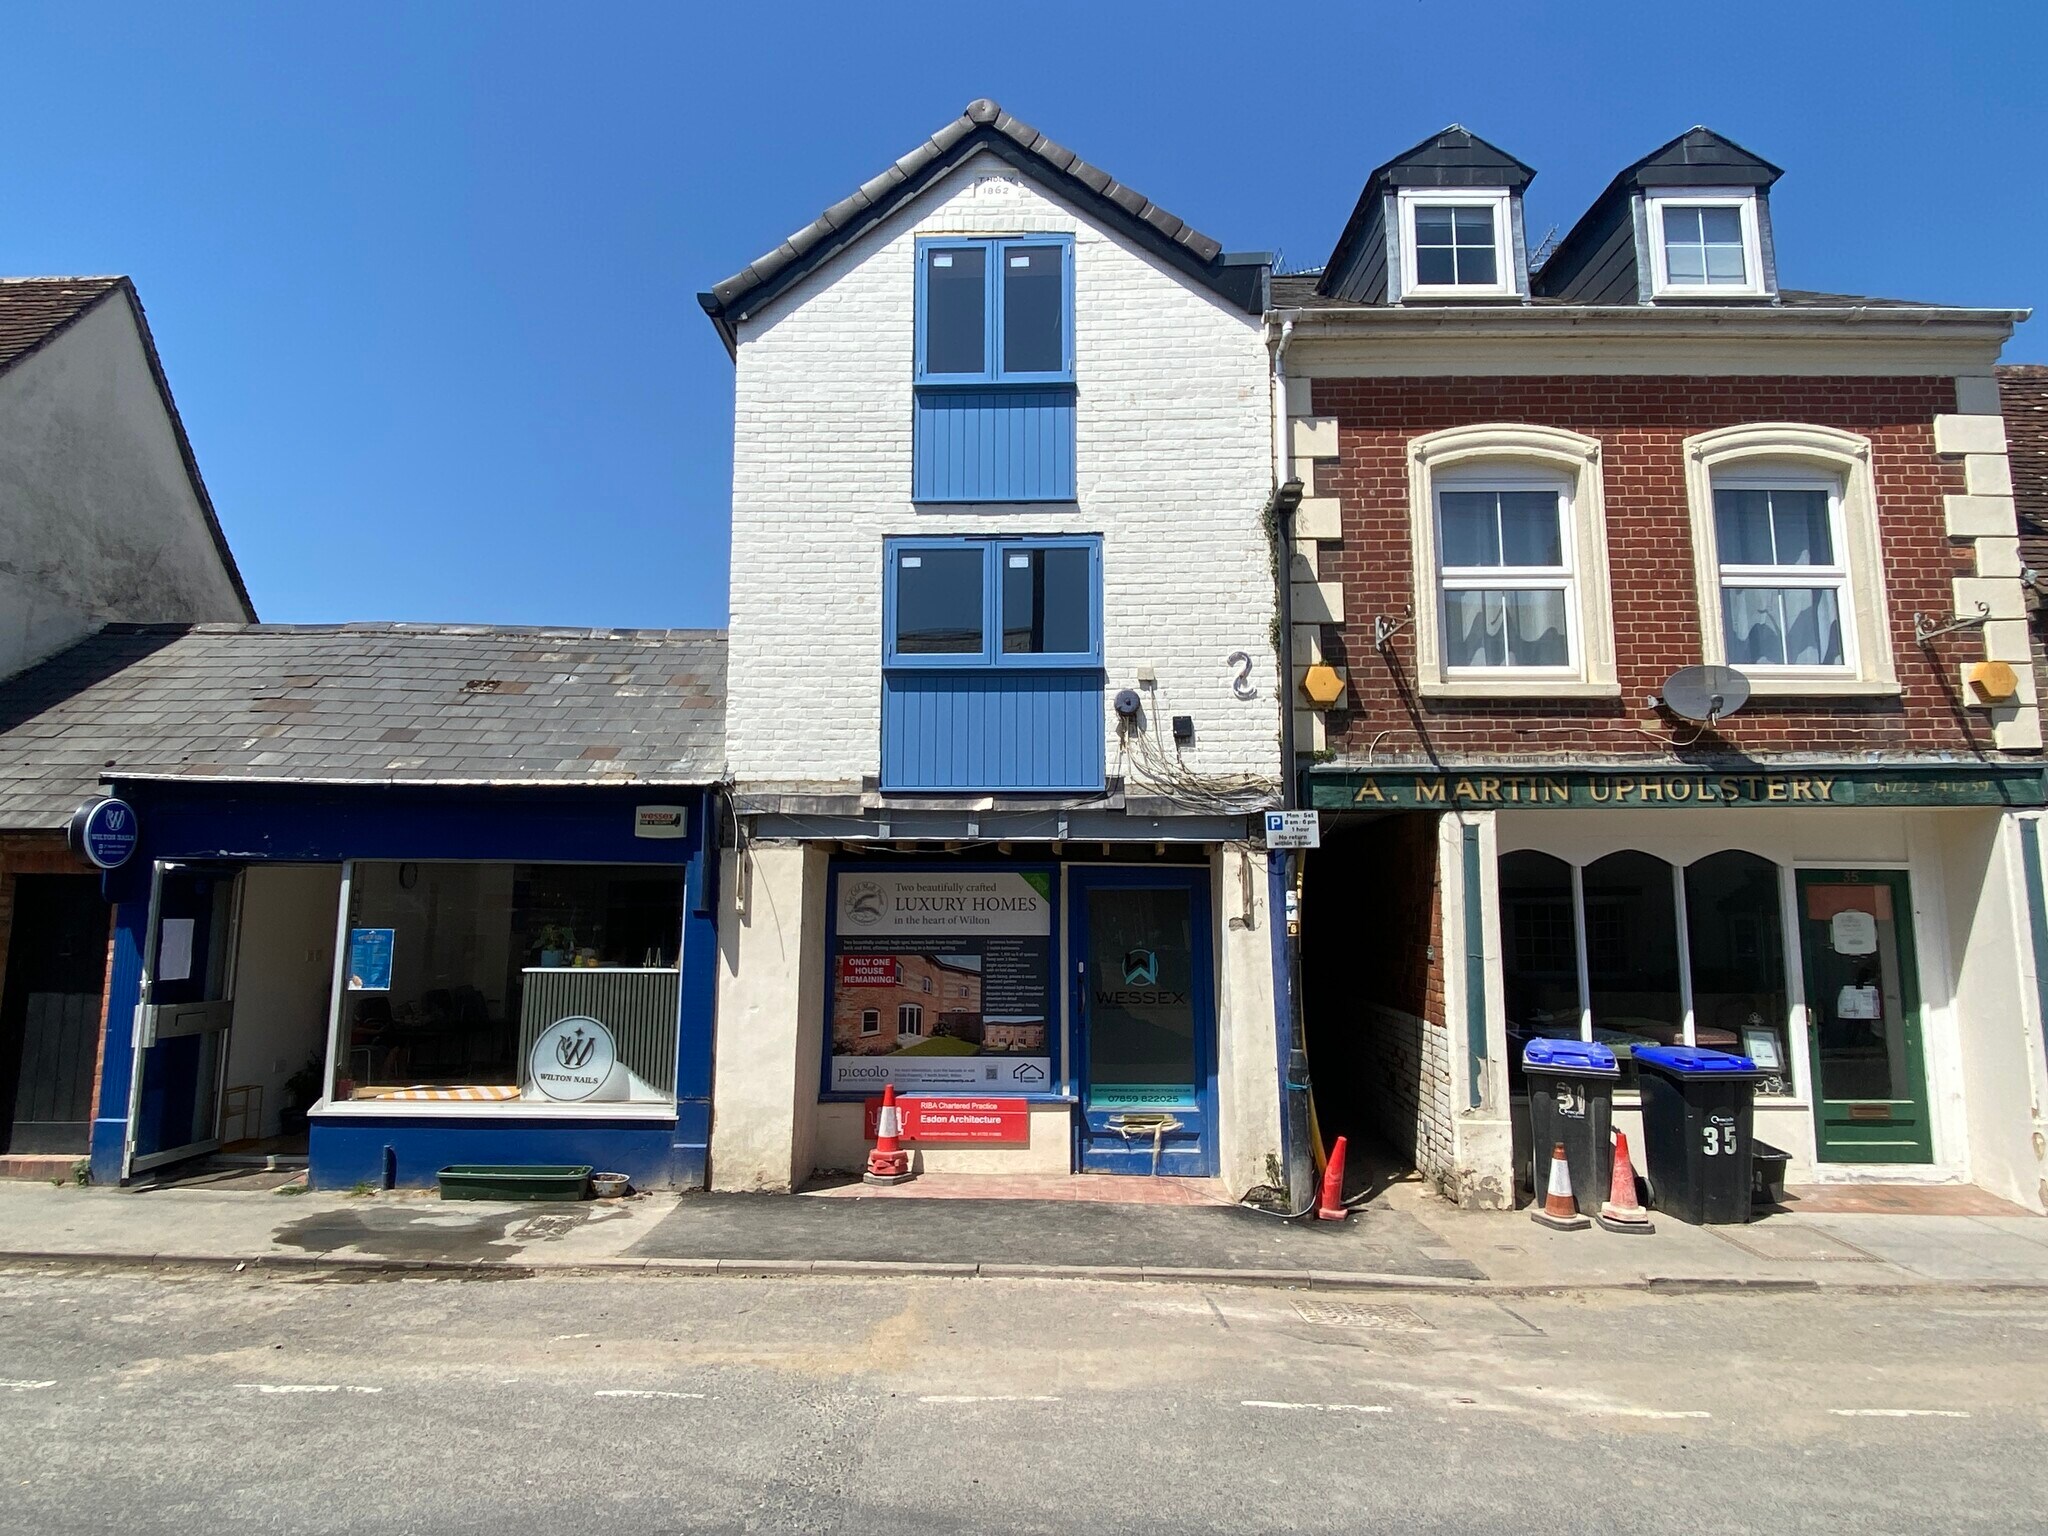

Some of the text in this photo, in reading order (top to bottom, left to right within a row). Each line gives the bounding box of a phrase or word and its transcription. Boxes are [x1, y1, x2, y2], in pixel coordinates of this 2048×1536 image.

[983, 186, 1009, 195] 1862
[1355, 775, 1834, 802] A. MARTIN UPHOLSTERY
[895, 883, 997, 893] Two beautifully crafted
[895, 897, 970, 911] LUXURY
[973, 897, 1037, 911] HOMES
[894, 915, 990, 925] in the heart of Wilton
[849, 958, 890, 966] ONLY ONE
[855, 967, 884, 975] HOUSE
[844, 976, 895, 984] REMAINING!
[1095, 991, 1185, 1005] WESSEX
[838, 1062, 889, 1081] piccolo
[540, 1073, 599, 1084] WILTON NAILS
[1107, 1095, 1179, 1103] 07859 822025
[920, 1102, 998, 1110] RIBA Chartered Practice
[920, 1115, 1002, 1124] Esdon Architecture
[1703, 1126, 1737, 1156] 35
